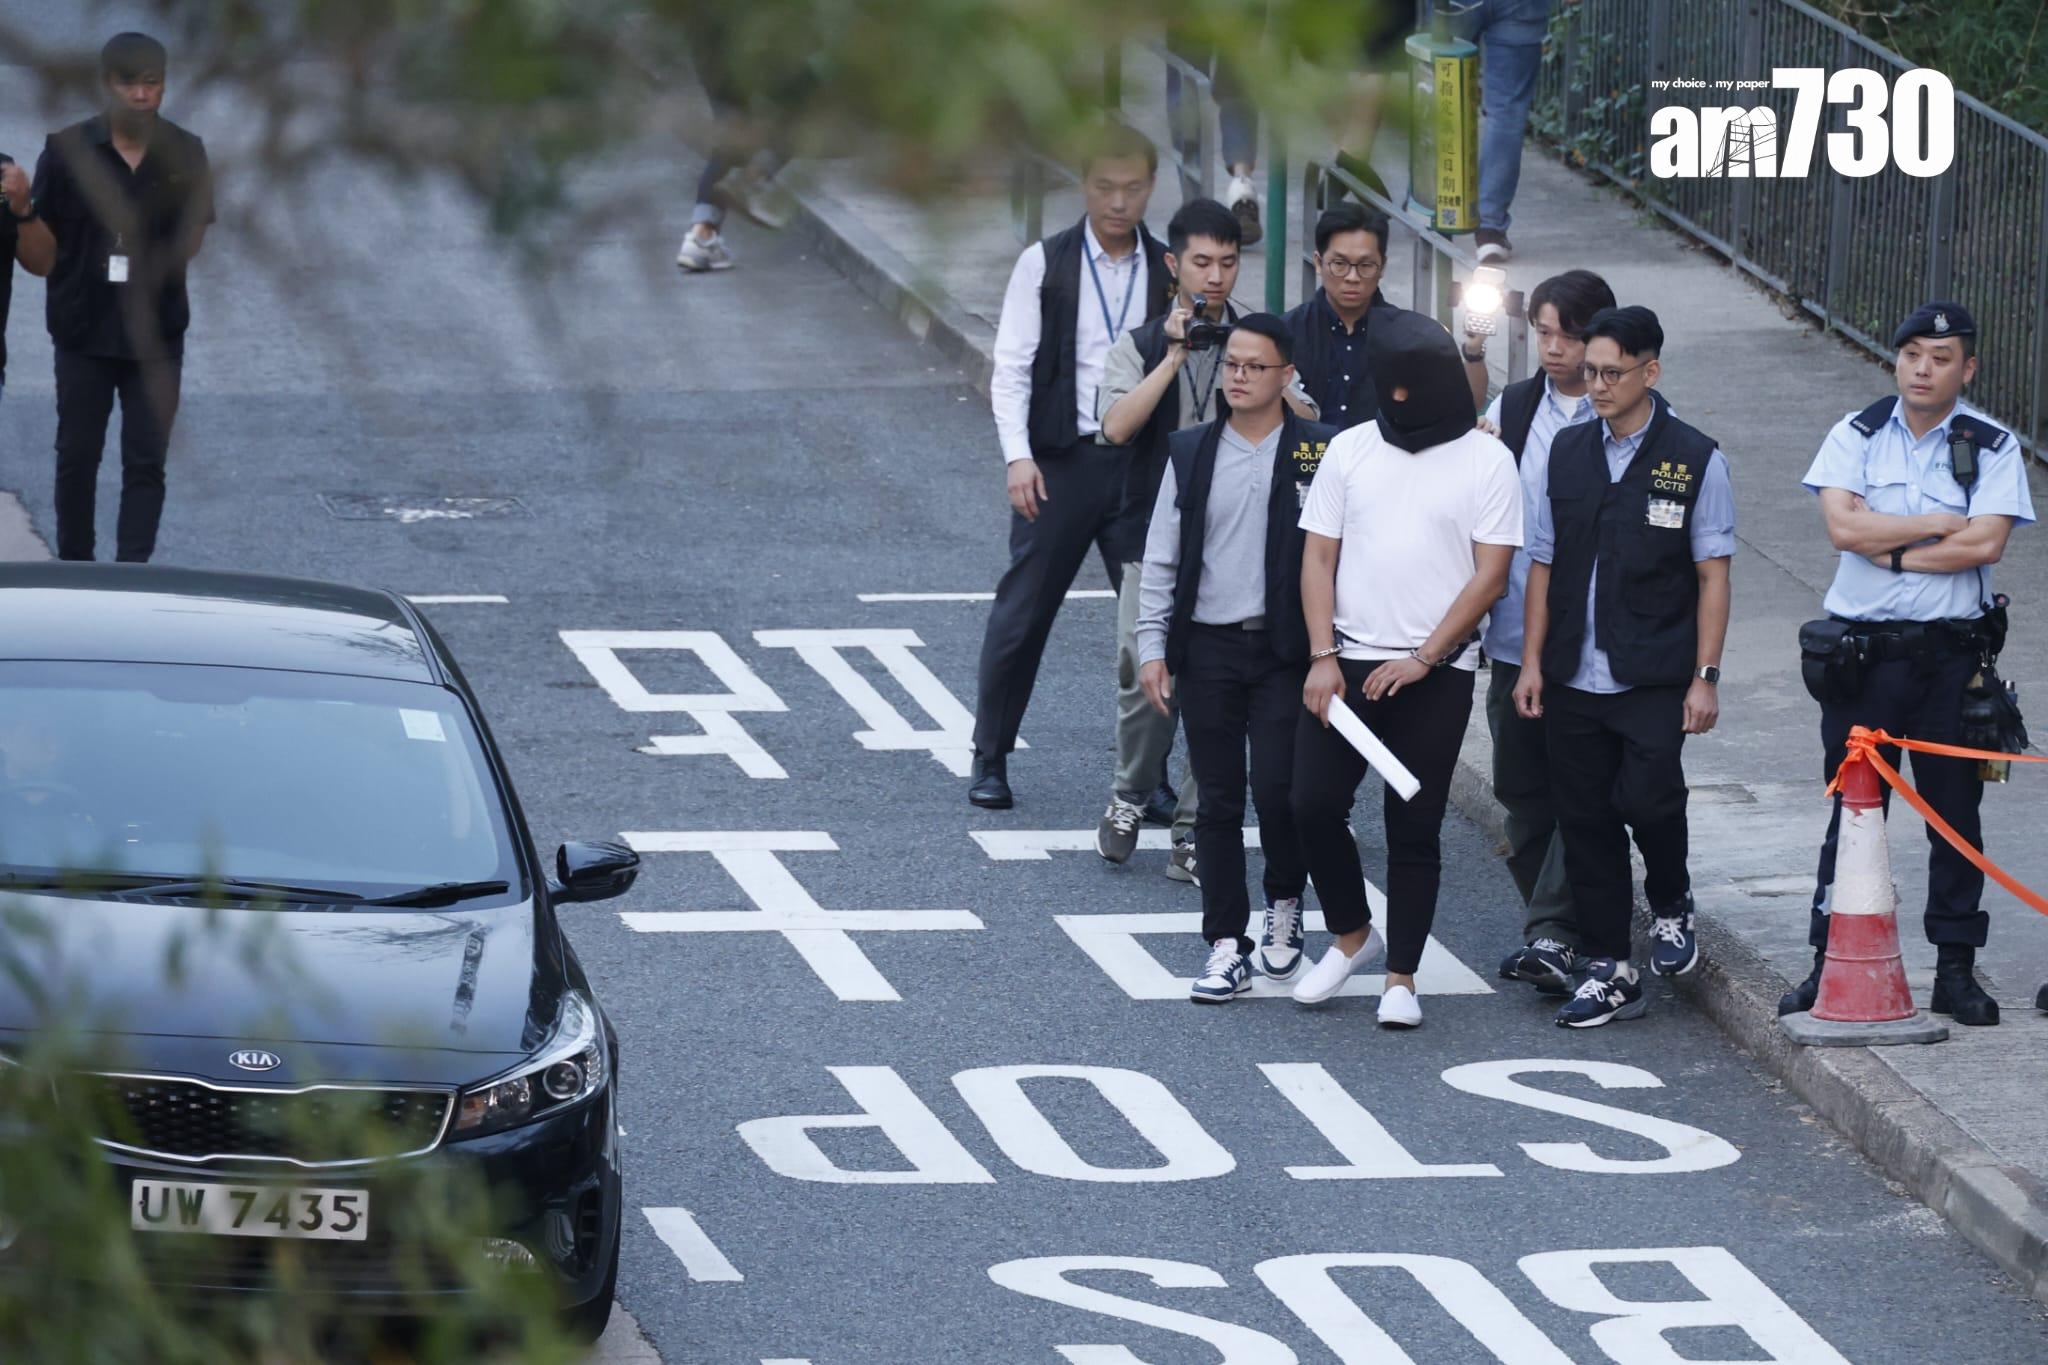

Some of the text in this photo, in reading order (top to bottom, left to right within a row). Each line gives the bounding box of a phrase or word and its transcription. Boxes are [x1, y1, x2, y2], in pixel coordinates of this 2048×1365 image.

[1439, 62, 1457, 194] 可指定送日期
[1293, 451, 1325, 461] POLIC
[1300, 463, 1320, 473] OC
[1651, 469, 1694, 481] POLICE
[1654, 479, 1687, 492] OCTB
[559, 629, 1029, 779] 站
[237, 1052, 273, 1066] KIA
[736, 1059, 1741, 1185] STOP
[140, 1185, 359, 1233] UW 7435
[988, 1246, 1852, 1365] BUS
